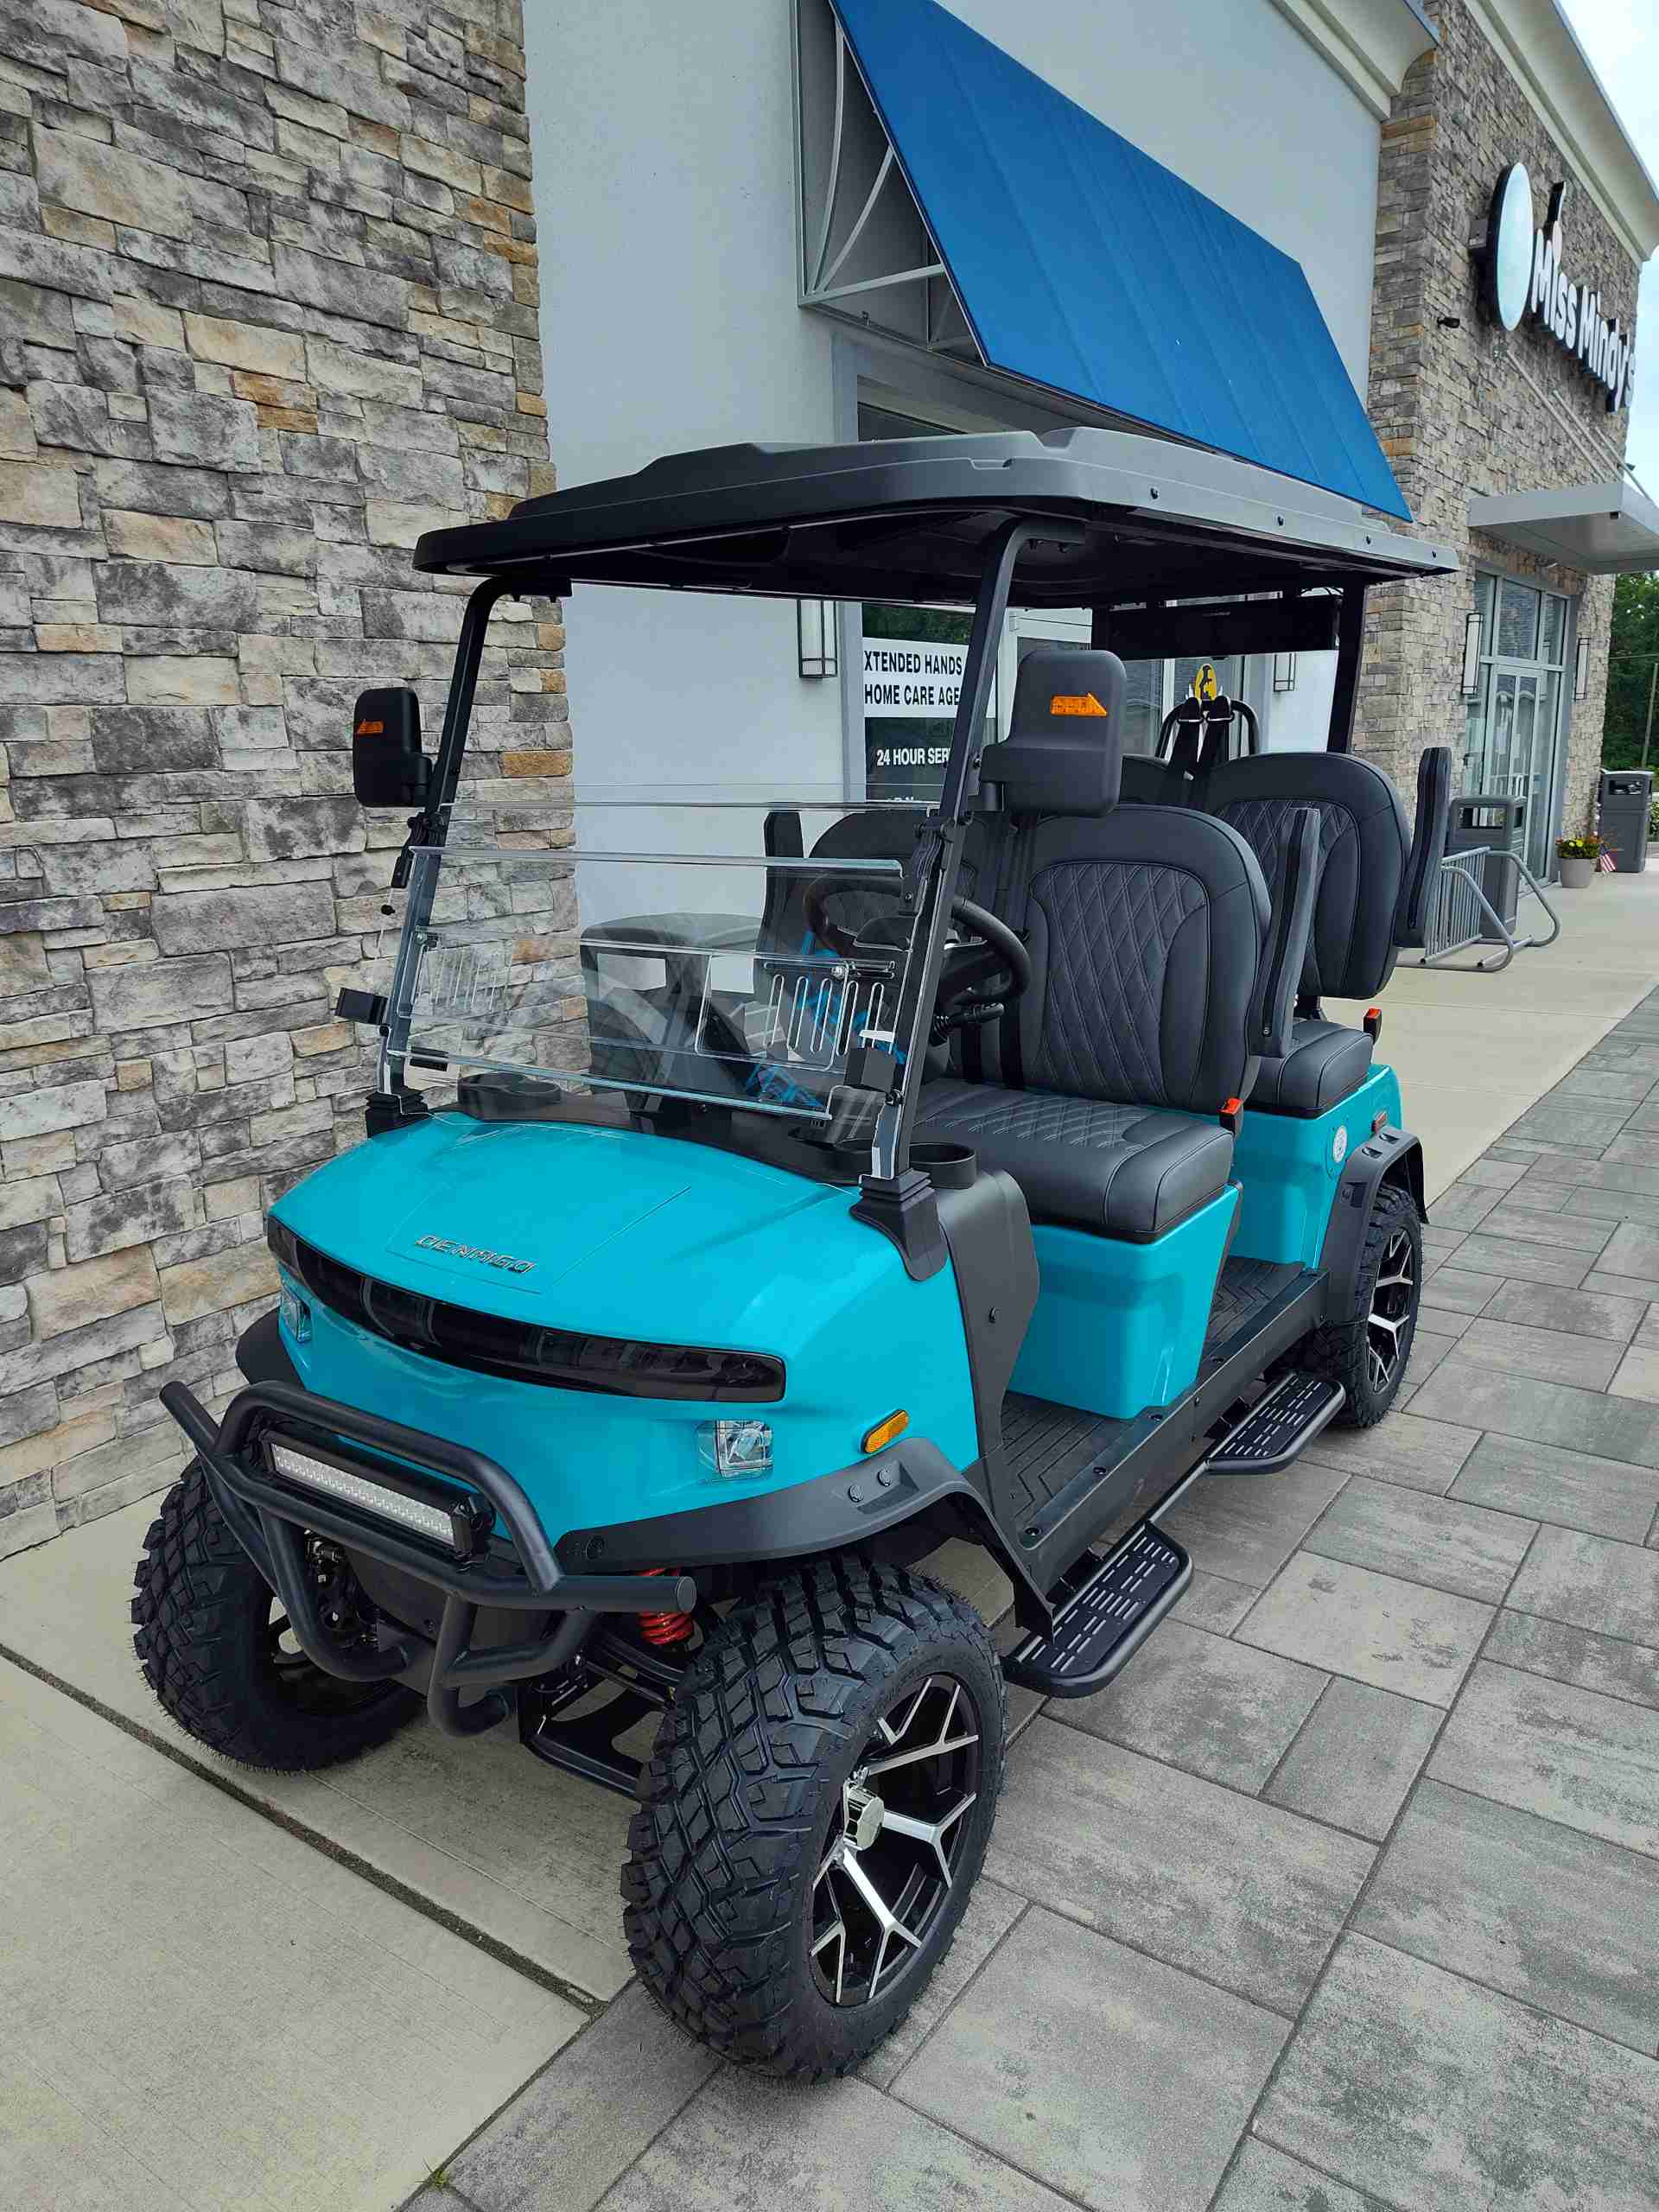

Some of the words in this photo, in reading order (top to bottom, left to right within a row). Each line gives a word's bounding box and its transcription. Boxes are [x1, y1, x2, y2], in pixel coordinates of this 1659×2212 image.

[863, 650, 921, 674] XTENDED
[925, 653, 963, 676] HANDS
[864, 683, 900, 705] HOME
[904, 685, 935, 706] CARE
[938, 686, 960, 706] AGE
[876, 747, 891, 766] 24
[893, 747, 925, 766] HOUR
[927, 747, 950, 764] SER
[415, 1234, 537, 1274] DENAGO
